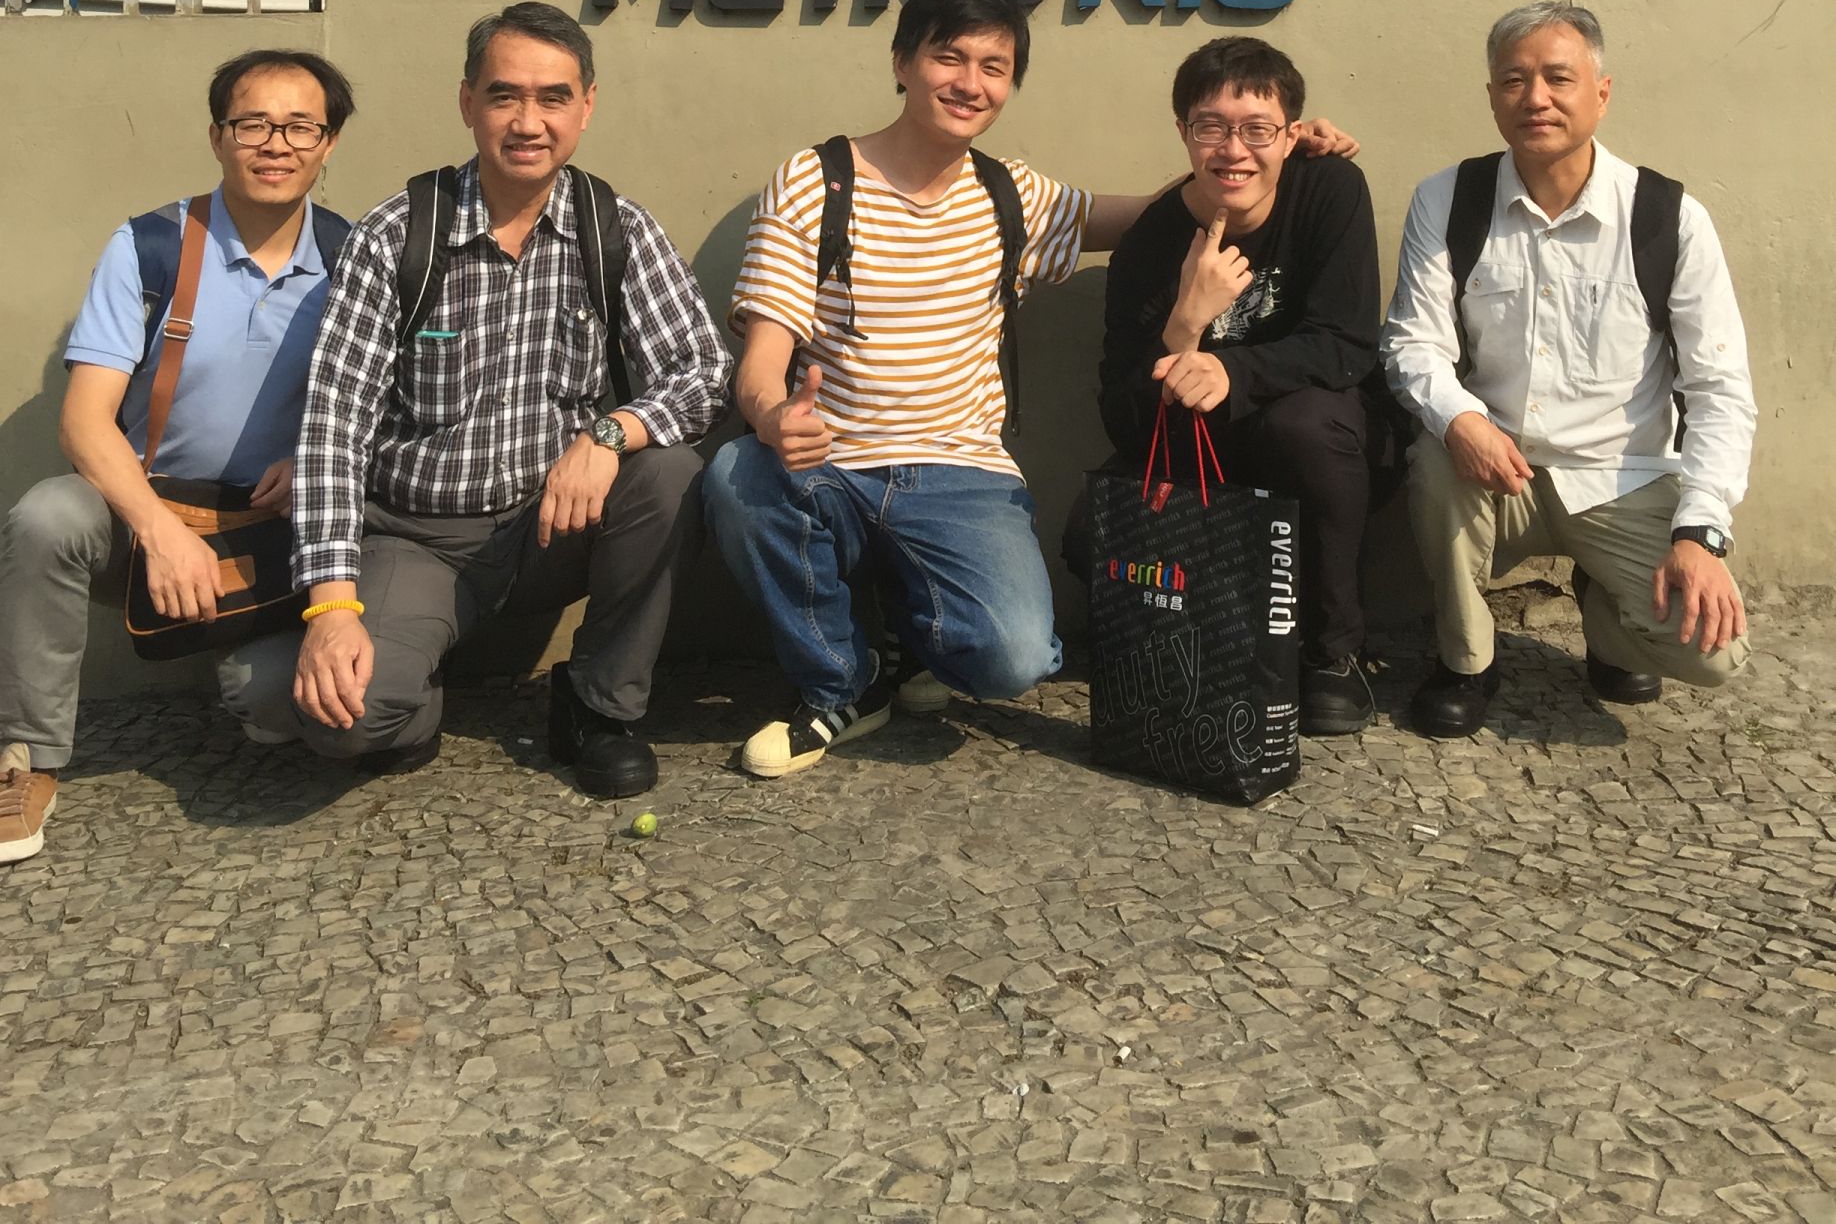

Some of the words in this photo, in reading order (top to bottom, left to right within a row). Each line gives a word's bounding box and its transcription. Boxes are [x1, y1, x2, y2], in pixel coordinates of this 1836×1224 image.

[1109, 558, 1185, 591] everrich
[1268, 520, 1297, 635] everrich
[1093, 625, 1201, 729] duty
[1143, 700, 1264, 783] free
